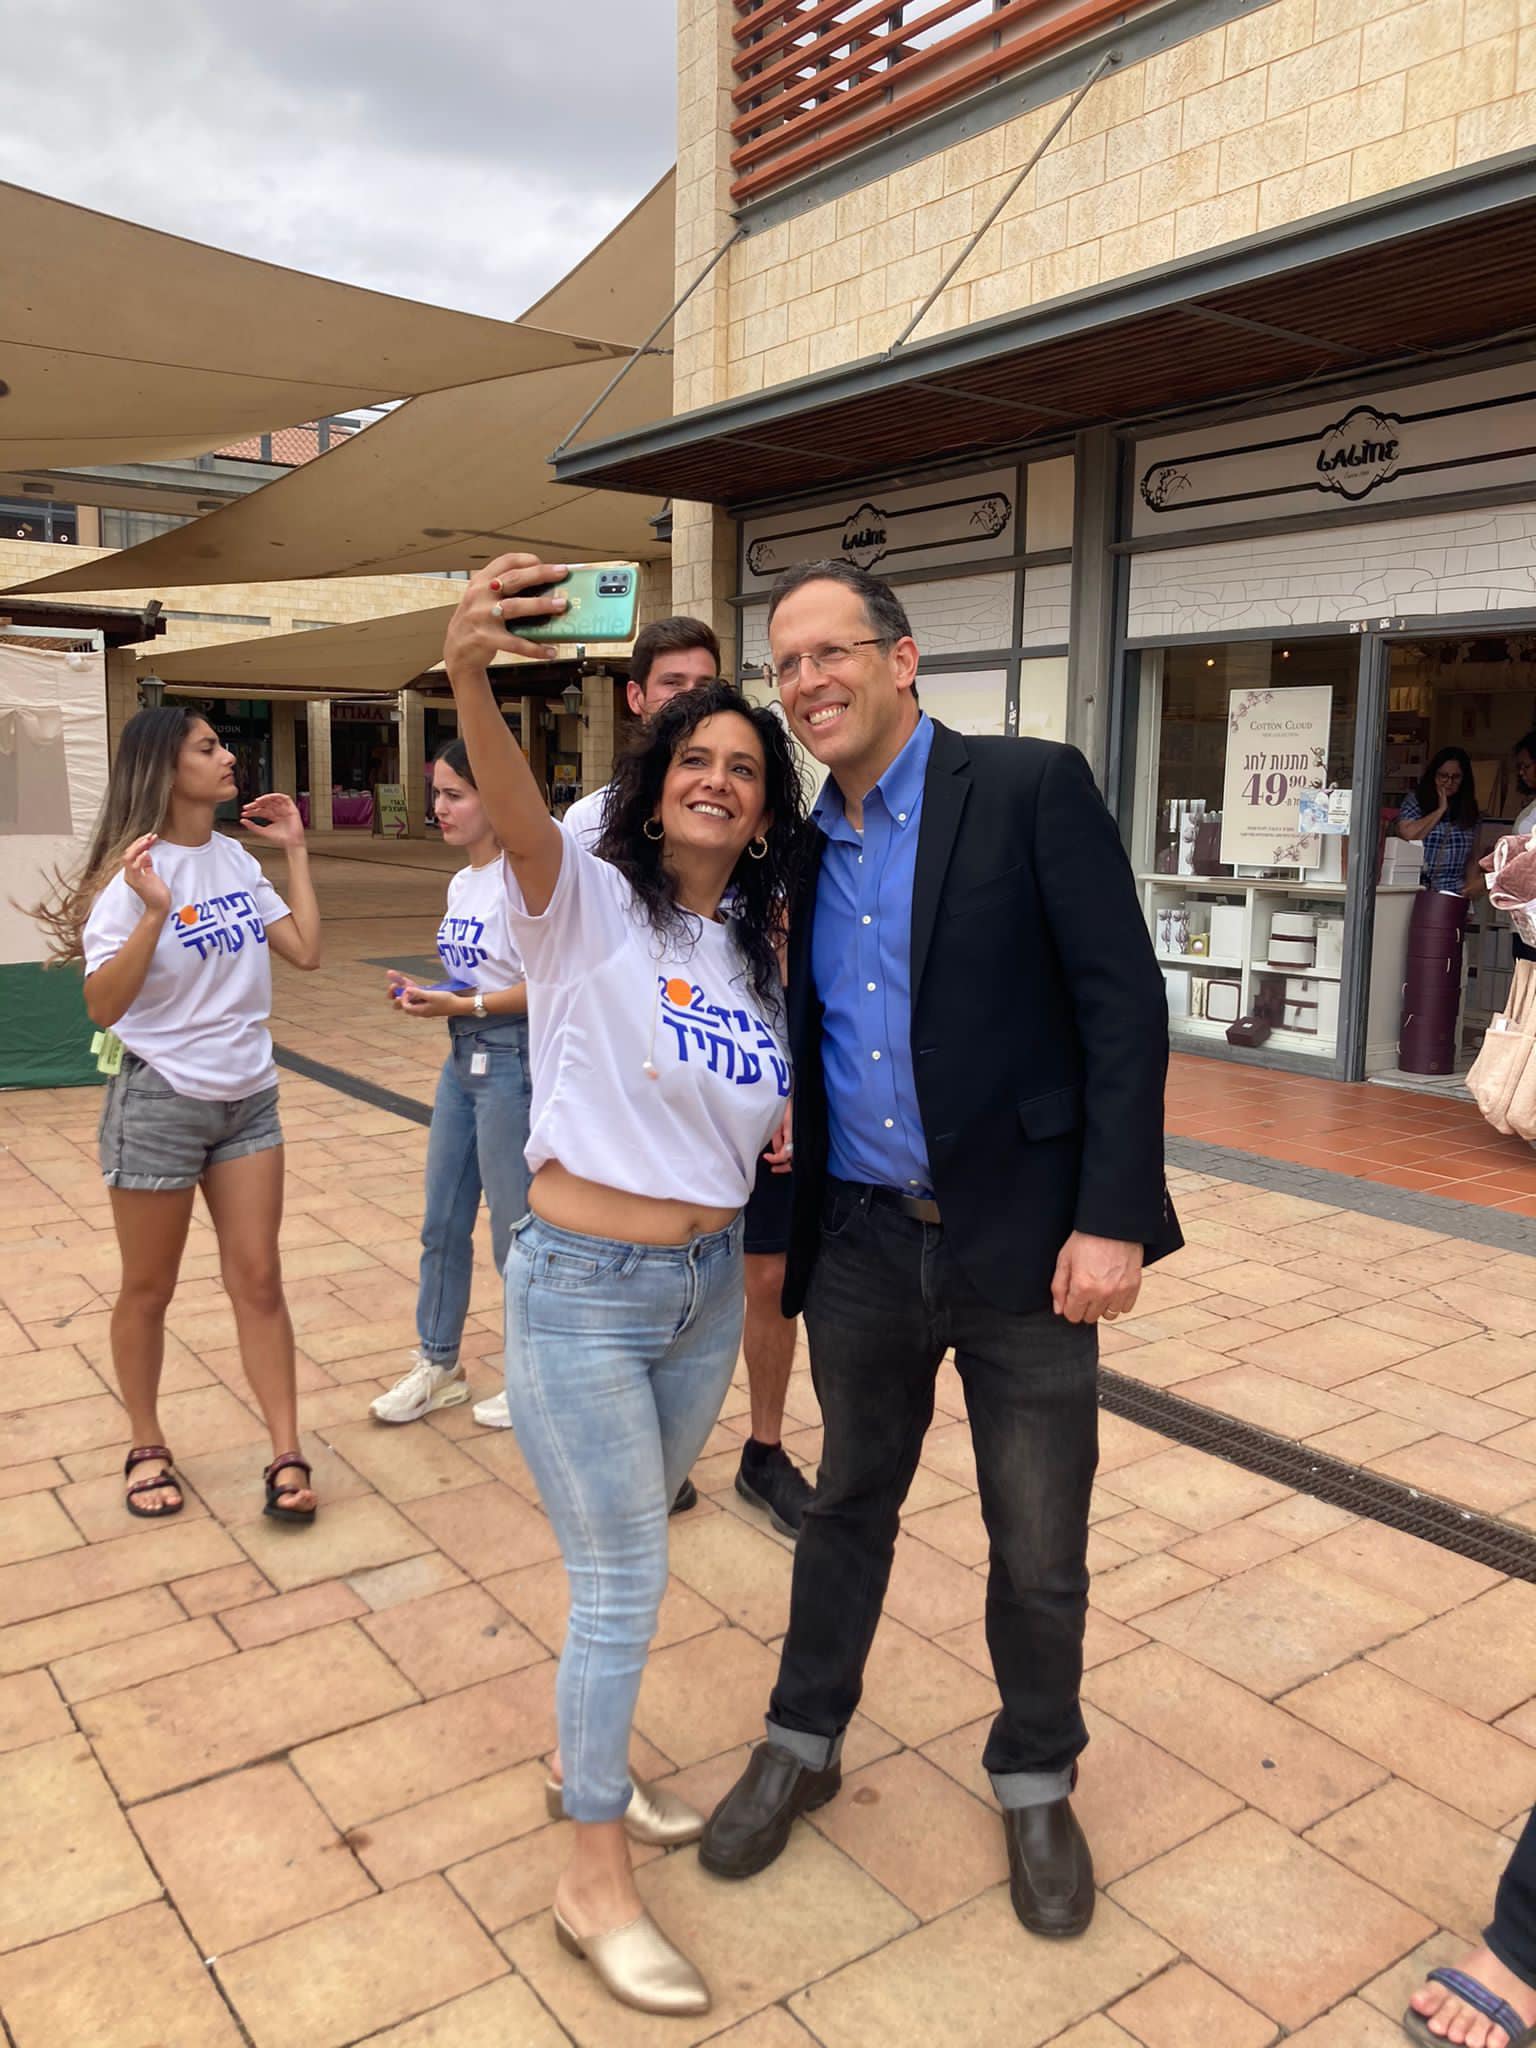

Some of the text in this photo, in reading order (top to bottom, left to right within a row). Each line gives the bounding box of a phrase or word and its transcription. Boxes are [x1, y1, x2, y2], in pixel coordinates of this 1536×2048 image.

[1243, 752, 1309, 770] מתנות לחג
[208, 891, 255, 922] פיד
[182, 917, 266, 960] ש עתיד
[716, 1006, 776, 1050] פיד
[663, 1014, 793, 1098] ש עתיד
